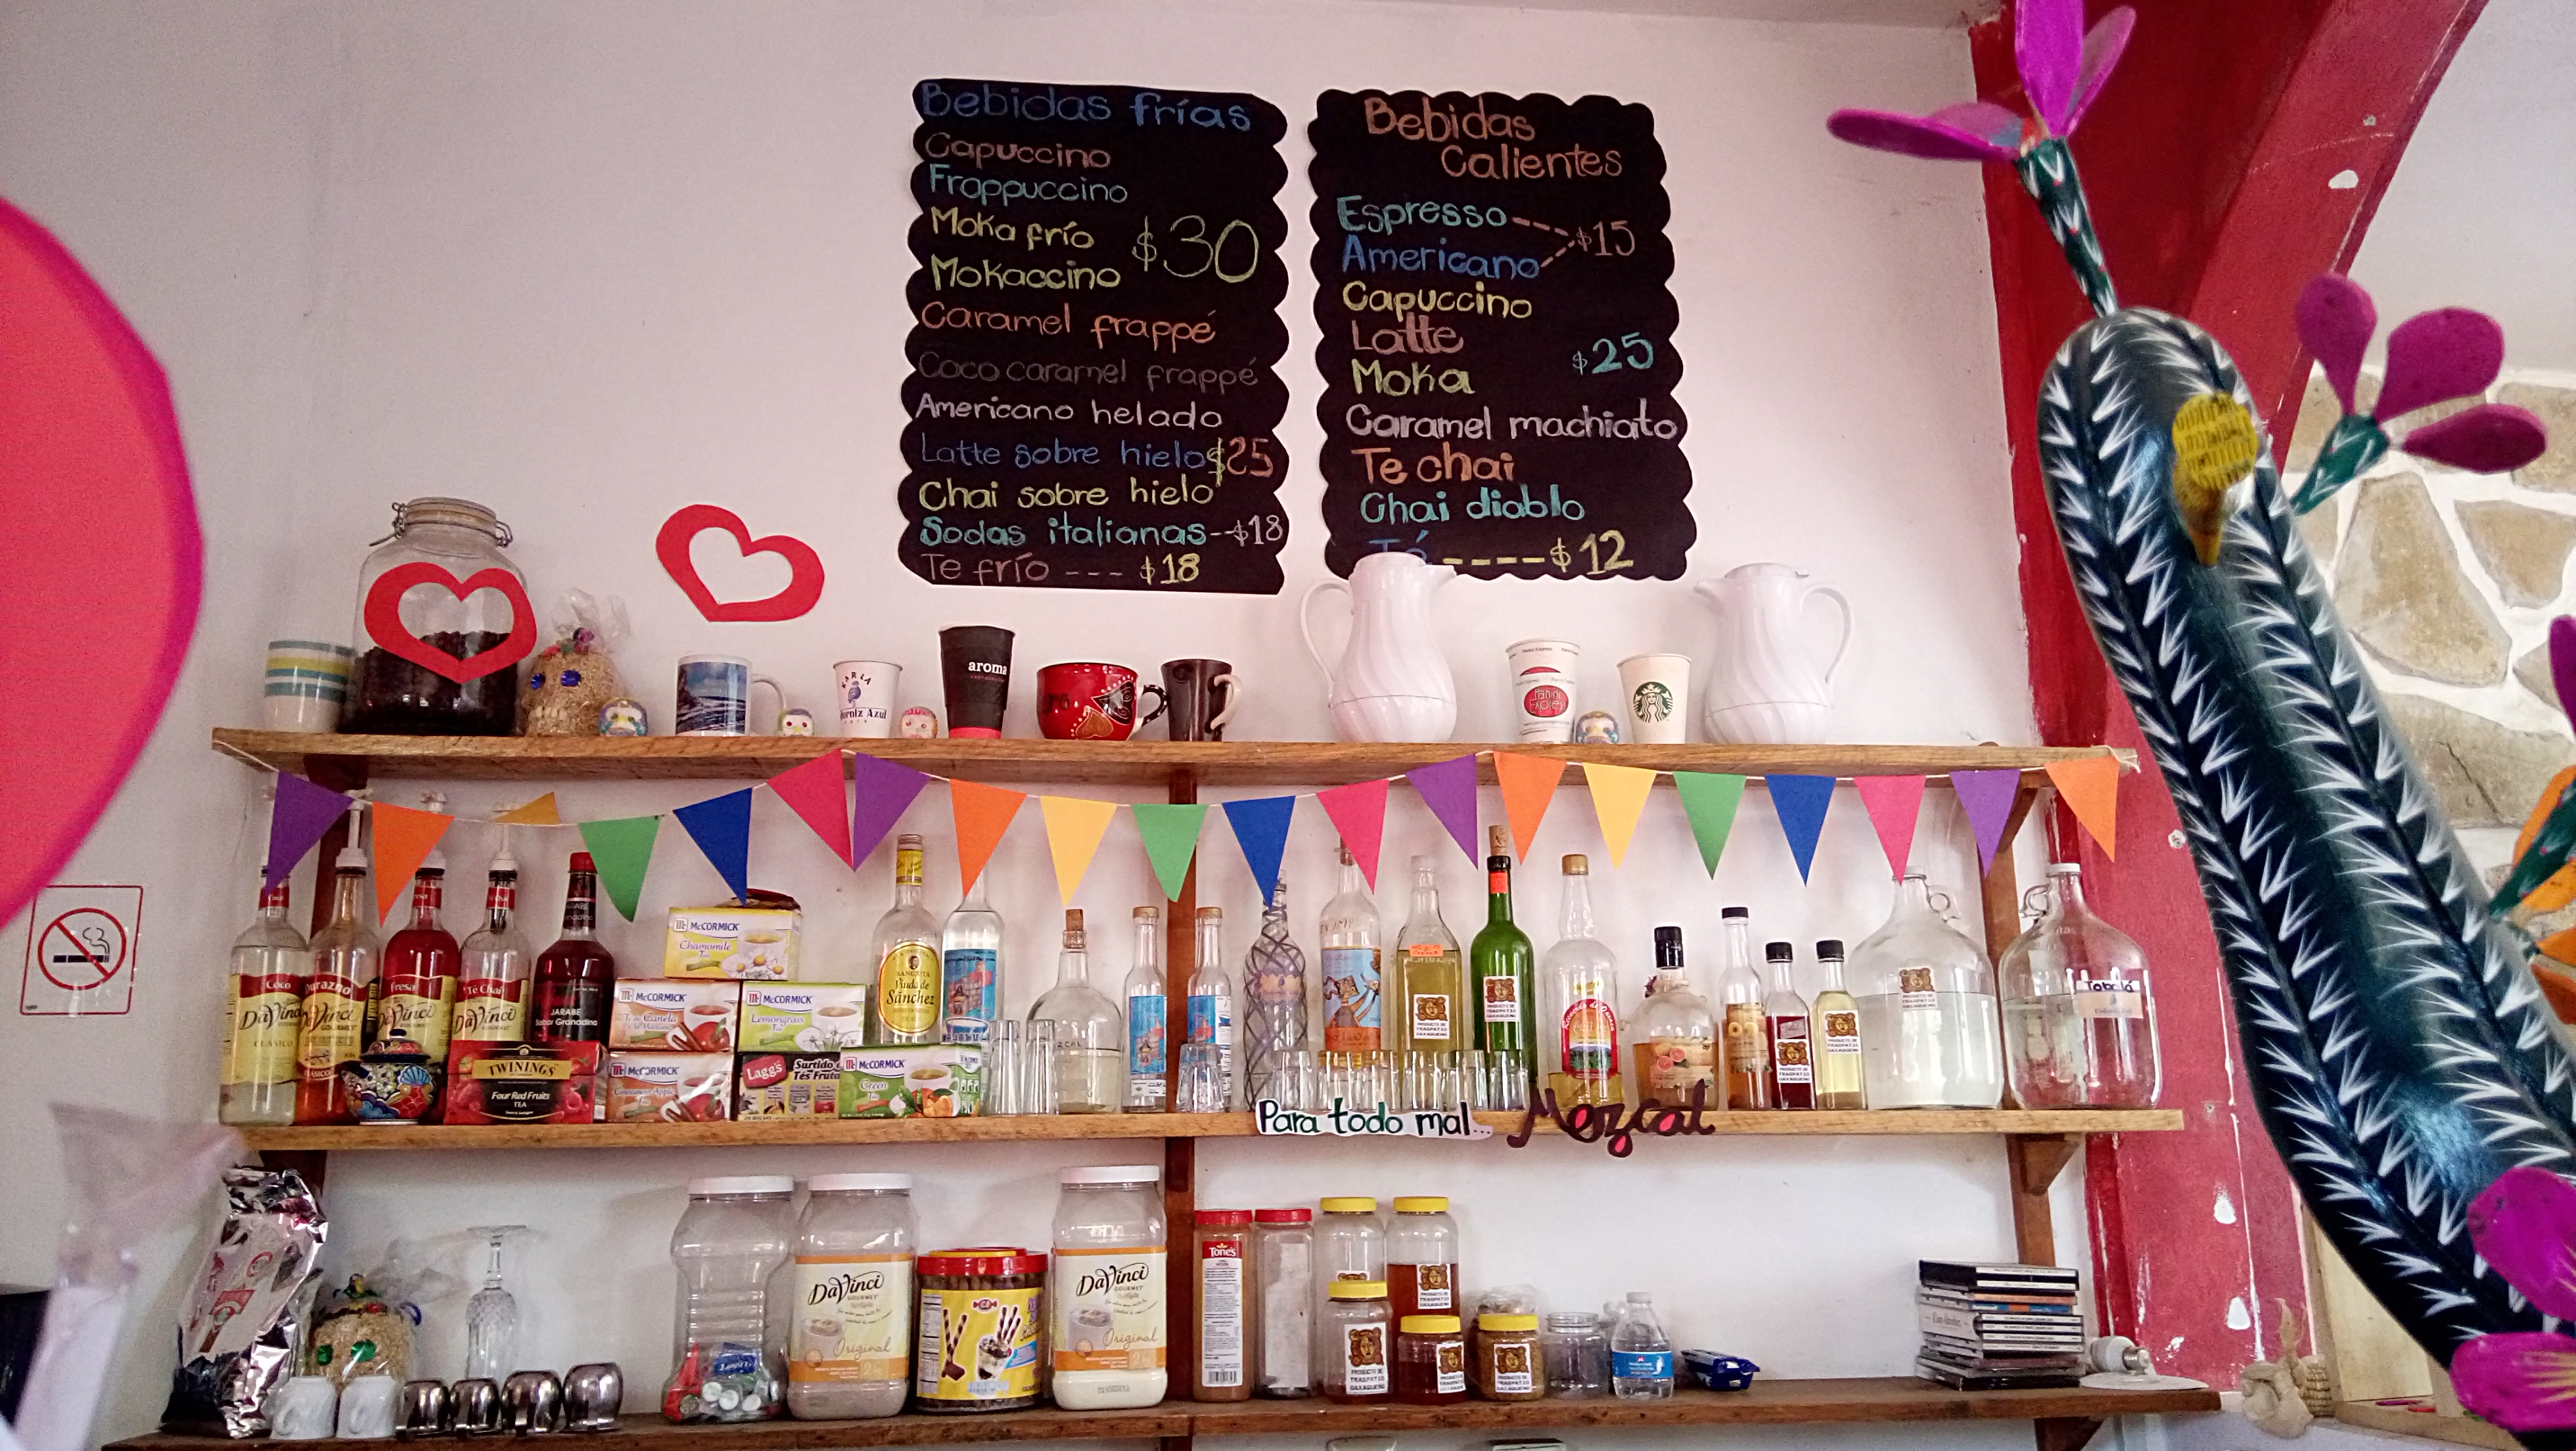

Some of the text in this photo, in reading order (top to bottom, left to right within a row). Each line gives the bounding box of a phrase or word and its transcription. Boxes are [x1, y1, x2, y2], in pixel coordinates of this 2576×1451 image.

[922, 81, 1250, 131] Bebidas frías
[1364, 95, 1535, 142] Bebidas
[925, 132, 1111, 168] Capuccino
[1441, 143, 1622, 179] Calientes
[929, 164, 1127, 206] Frappuccino
[931, 206, 1094, 250] Moka frío
[1337, 195, 1507, 235] Espresso
[1132, 215, 1258, 283] $30
[1343, 234, 1540, 279] Americano
[1575, 219, 1636, 258] $15
[931, 254, 1121, 290] Mokaccino
[1343, 281, 1532, 321] Capuccino
[921, 301, 1216, 353] Caramel frappé
[1352, 313, 1463, 354] Latte
[1571, 331, 1654, 375] $25
[919, 352, 1257, 394] Coco caramel frappé
[1352, 357, 1475, 396] Moka
[916, 393, 1222, 430] Americano helado
[1346, 398, 1678, 440] Caramel machiato
[922, 432, 1274, 488] Latte sobre hielo $25
[1351, 441, 1513, 484] Te chai
[919, 474, 1213, 511] Chai sobre hielo
[1360, 483, 1584, 524] Chai diablo
[920, 515, 1025, 547] Sodas
[1047, 511, 1207, 548] italianas
[920, 552, 1200, 586] Te frío $18
[1549, 529, 1634, 576] $12
[968, 661, 1007, 676] aroma
[867, 708, 886, 720] Azul
[690, 922, 740, 931] McCORMICK
[679, 940, 732, 951] Chamomile
[266, 980, 291, 990] Coco
[391, 982, 417, 993] Fresa
[635, 992, 687, 1002] McCORMICK
[763, 995, 814, 1004] McCORMICK
[886, 989, 934, 1005] Sánchez
[921, 980, 929, 990] de
[453, 1004, 517, 1034] DaVinci
[751, 1013, 804, 1026] Lemongrass
[488, 1061, 557, 1077] TWININGS
[747, 1062, 783, 1080] Lagg's
[794, 1059, 834, 1070] Surtido
[859, 1059, 906, 1069] McCORMICK
[492, 1091, 550, 1100] Four Red Fruits
[860, 1079, 887, 1089] Green
[1258, 1099, 1322, 1134] Para
[1328, 1097, 1404, 1134] todo
[1507, 1078, 1716, 1158] Mezcal
[1208, 1247, 1237, 1257] Tone's
[808, 1271, 885, 1305] DaVinci
[1076, 1262, 1149, 1297] DaVinci
[833, 1336, 892, 1360] Original
[1103, 1326, 1158, 1350] Original
